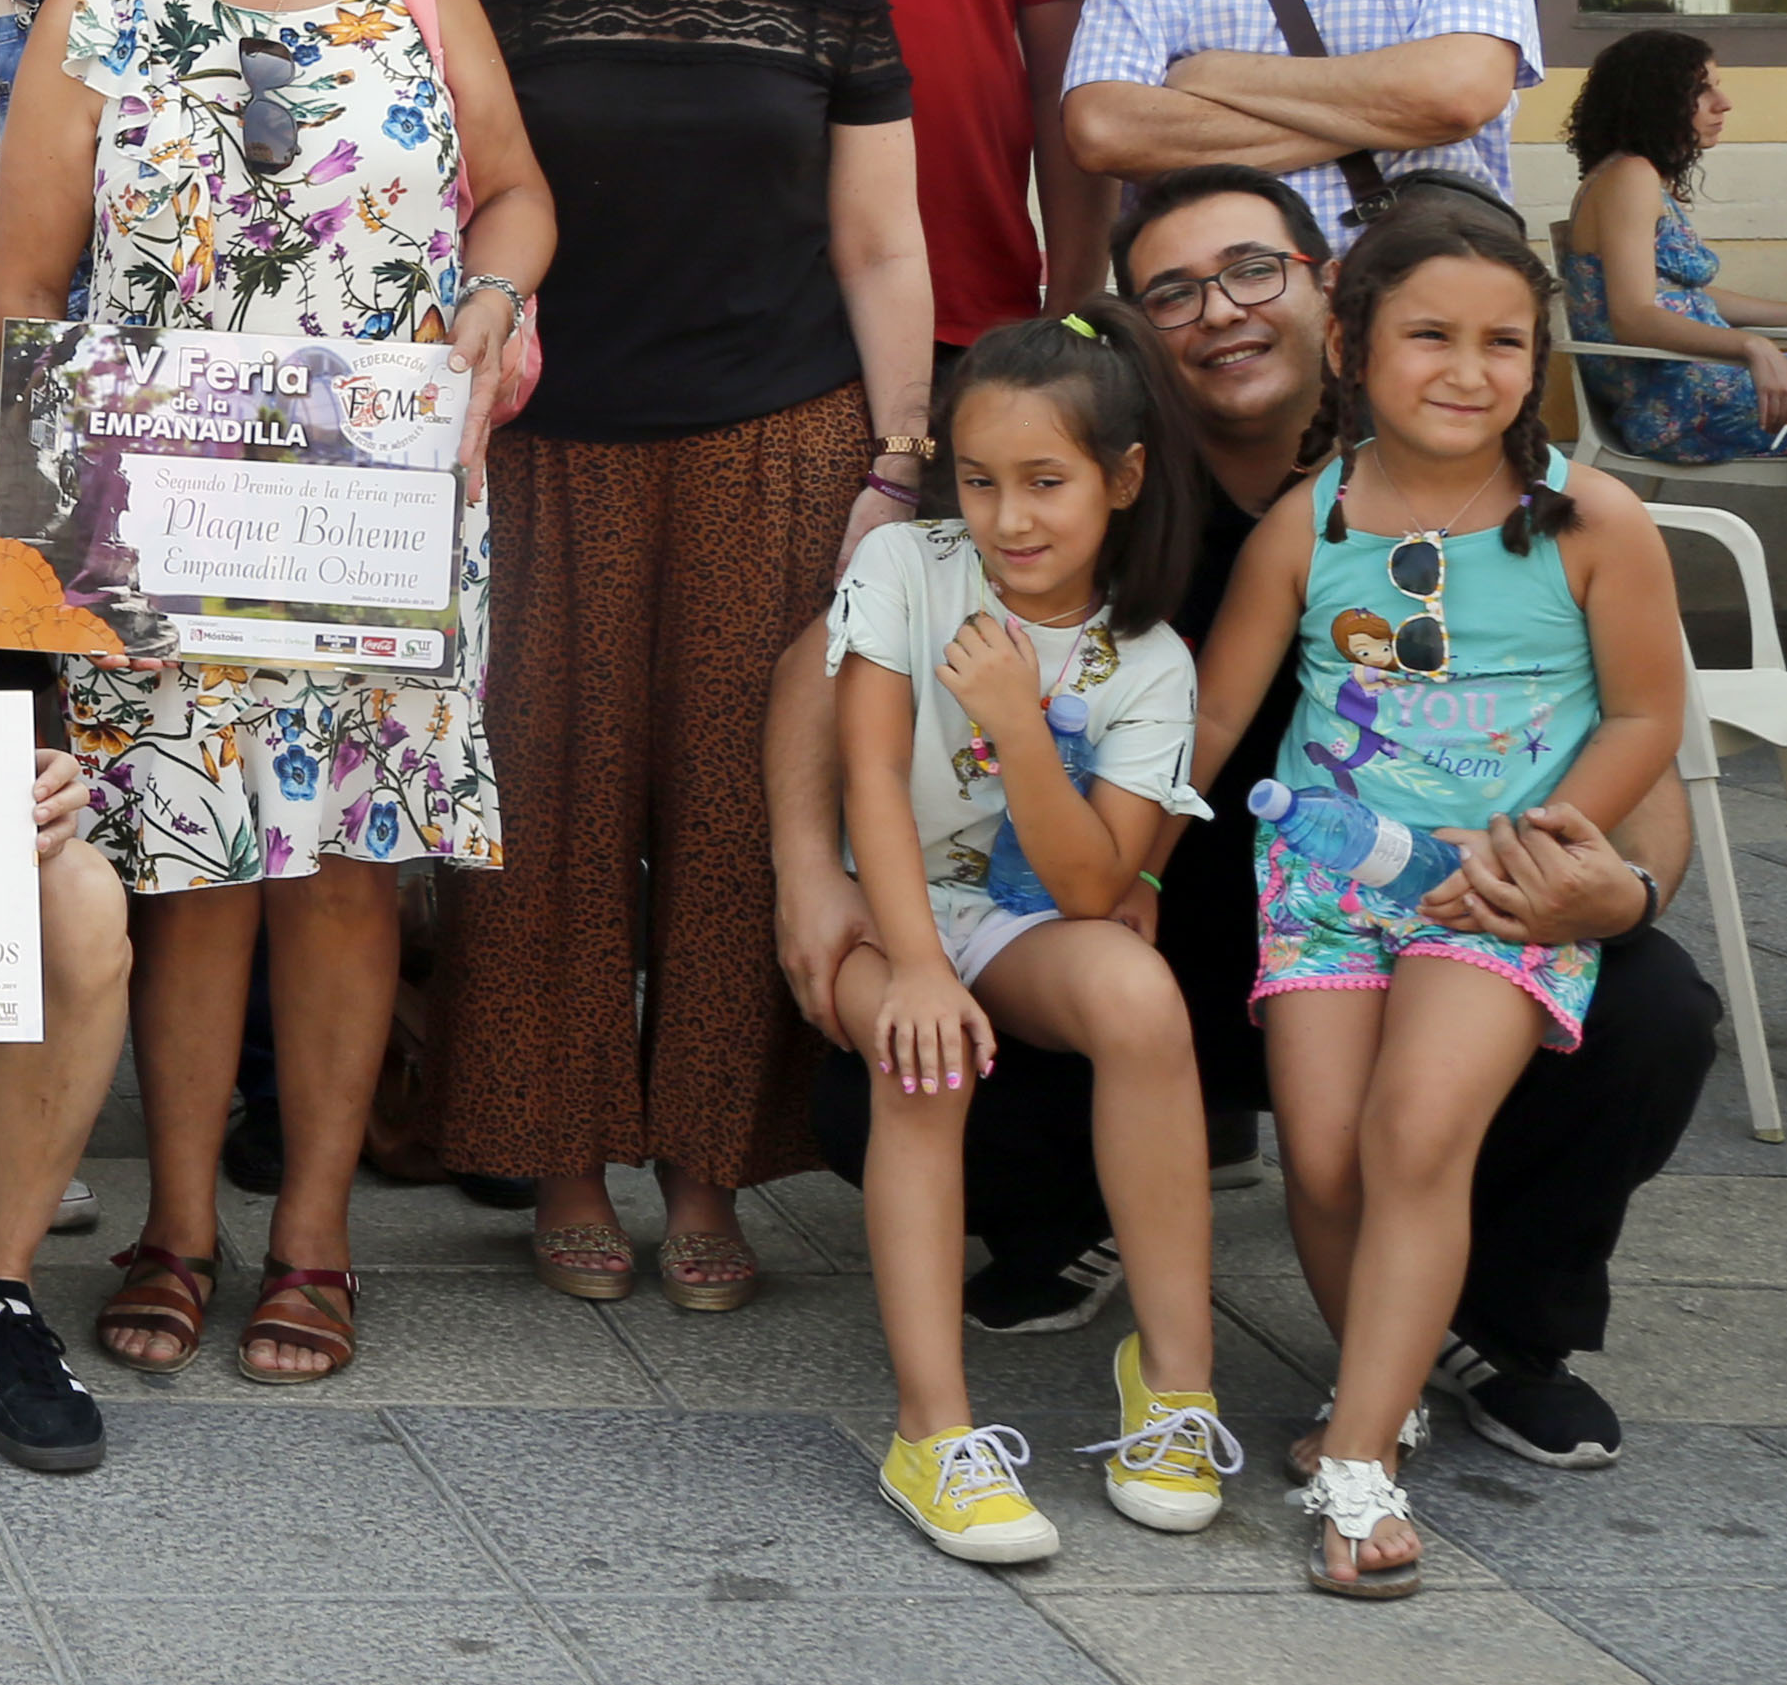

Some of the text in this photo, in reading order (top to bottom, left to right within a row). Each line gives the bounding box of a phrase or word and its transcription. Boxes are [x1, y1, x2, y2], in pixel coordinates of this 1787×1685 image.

[124, 344, 310, 394] V Feria
[172, 392, 227, 414] de la
[89, 413, 307, 448] EMPANADILLA
[154, 469, 437, 507] Segundo Premio de la Feria para:
[163, 498, 426, 552] Plaque Boheme
[163, 546, 419, 588] Empanadilla Osborne
[1393, 684, 1499, 731] YOU
[1424, 748, 1504, 778] them
